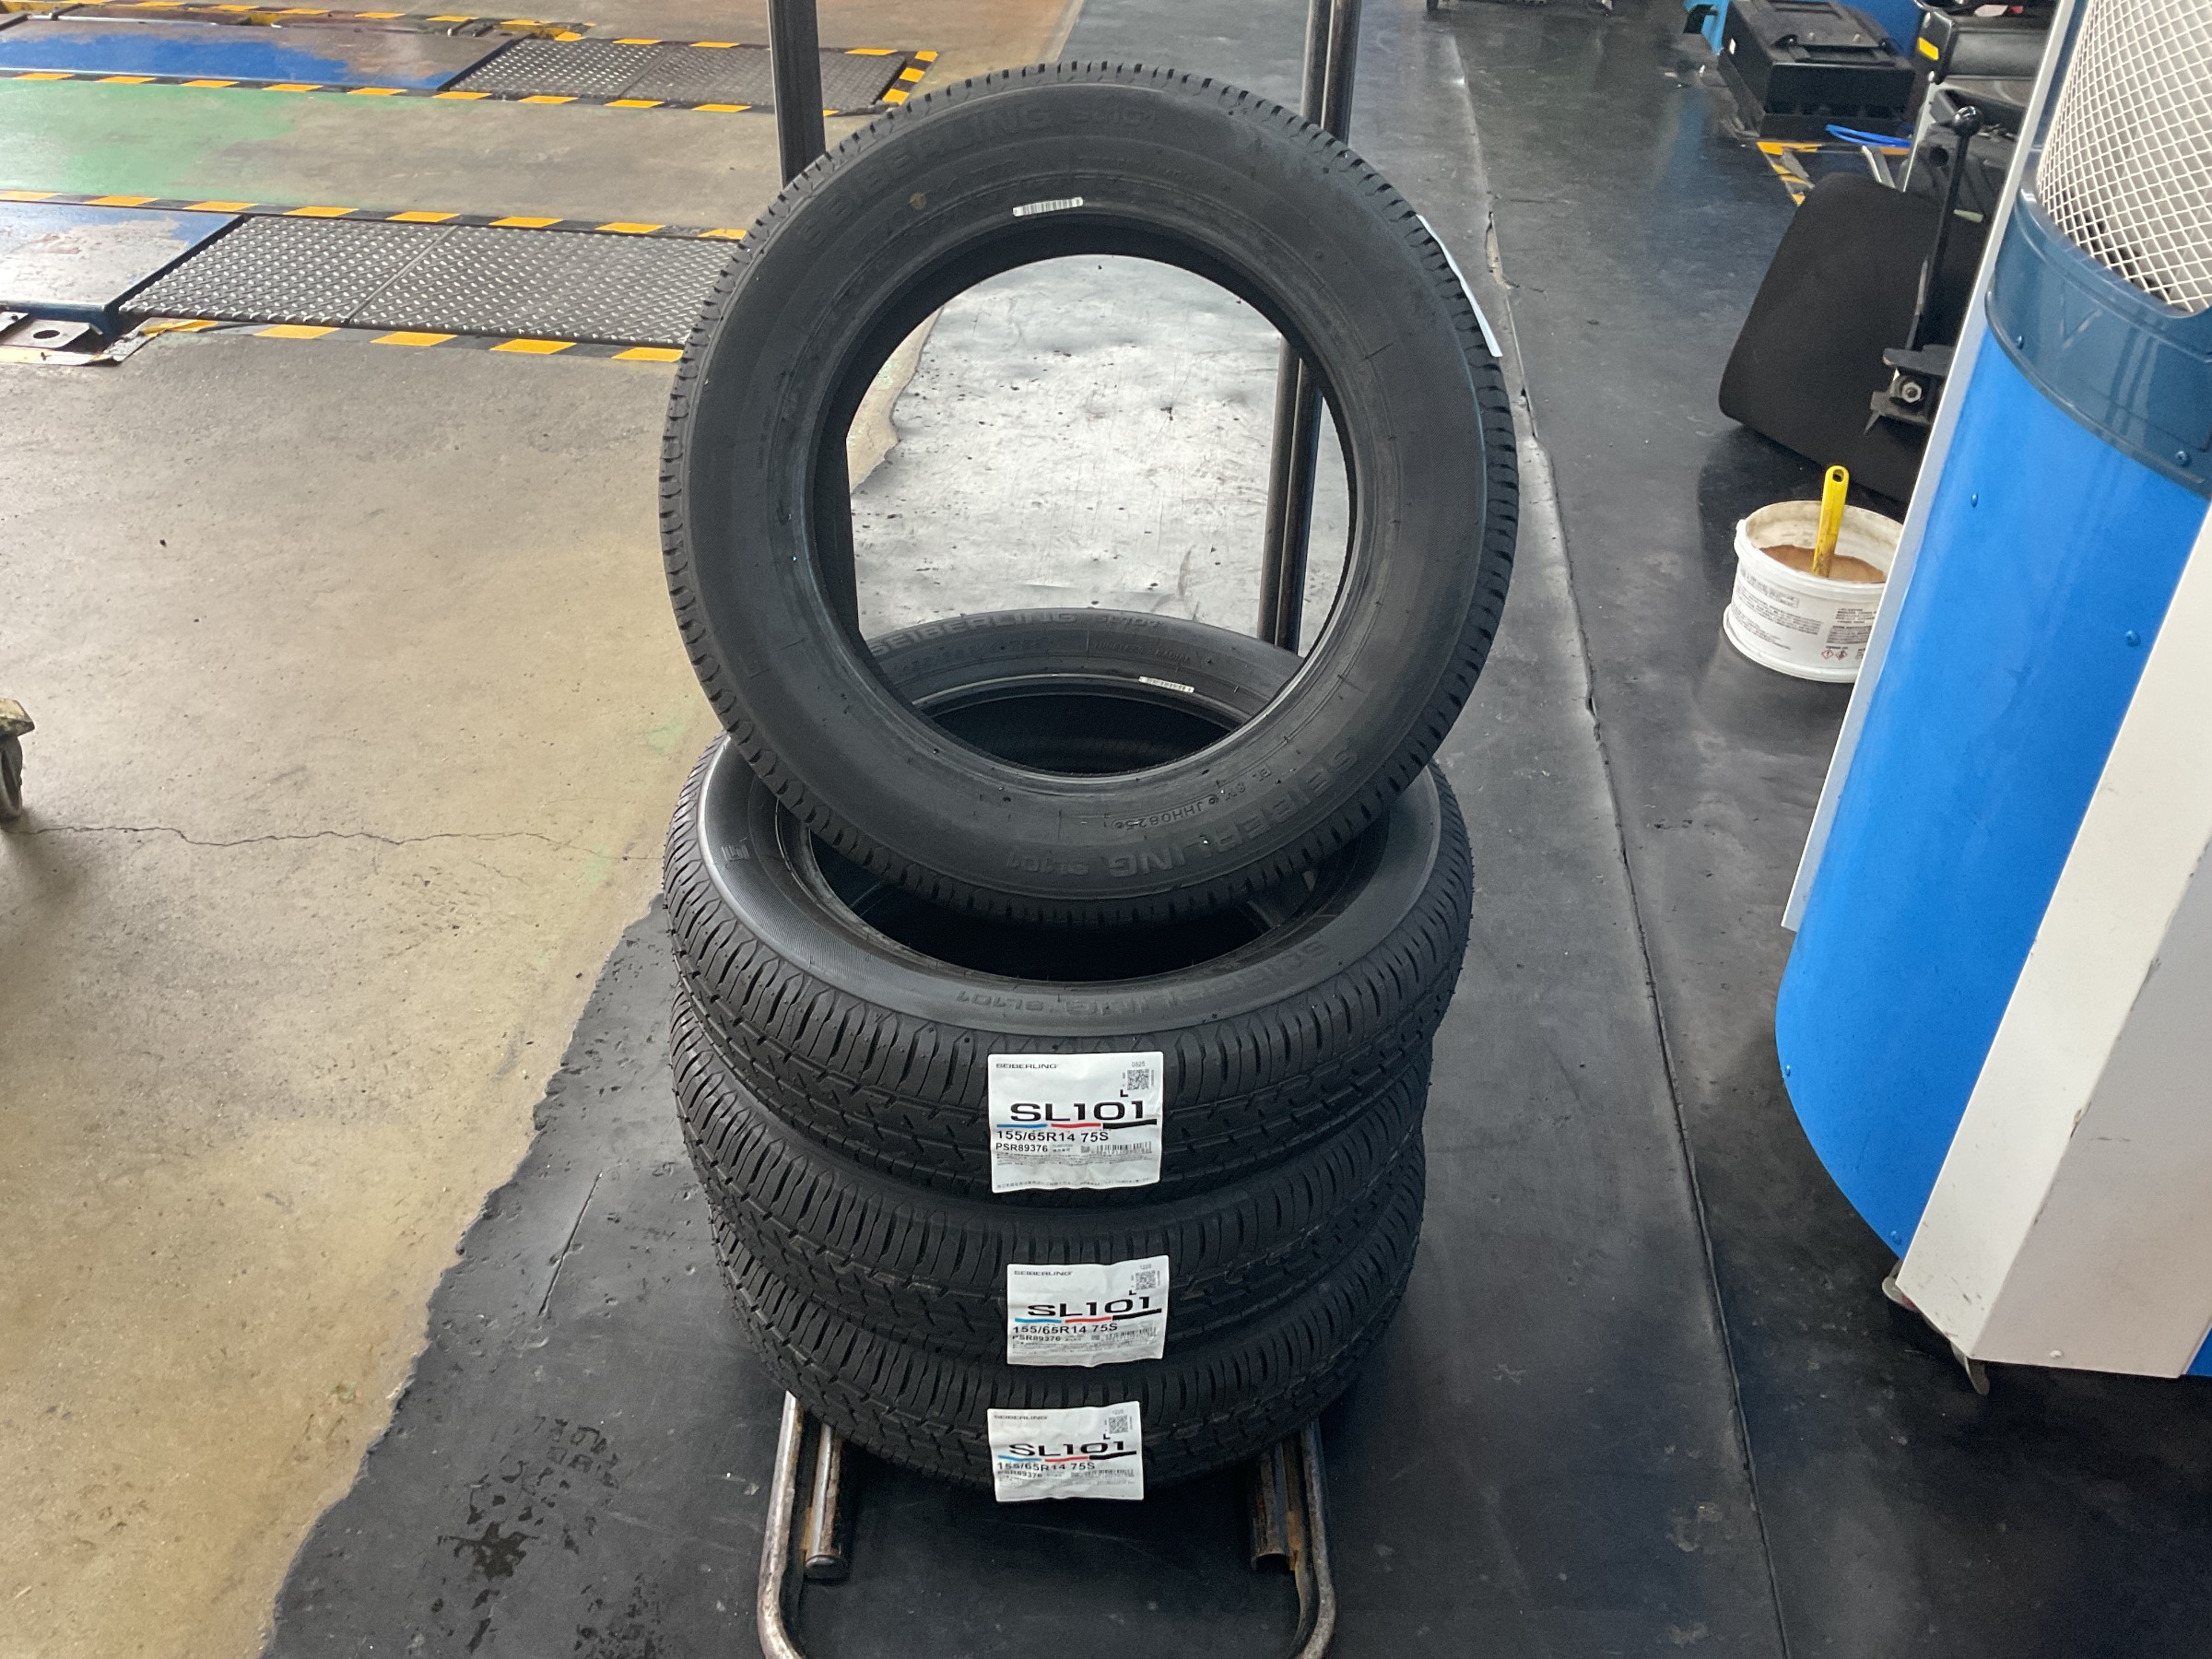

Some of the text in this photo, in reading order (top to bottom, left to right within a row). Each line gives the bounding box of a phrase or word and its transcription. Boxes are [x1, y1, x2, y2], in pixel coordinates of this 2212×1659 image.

[1107, 747, 1359, 878] SEIBERLING
[1120, 1089, 1129, 1098] L
[1010, 1100, 1144, 1122] SL101
[996, 1130, 1110, 1143] 155/65R14 75S
[995, 1142, 1049, 1153] PSR89376
[1028, 1296, 1150, 1318] SL101
[1012, 1323, 1118, 1335] 155/65R14 75S
[1008, 1441, 1124, 1457] SL101
[1070, 1462, 1096, 1472] 75S
